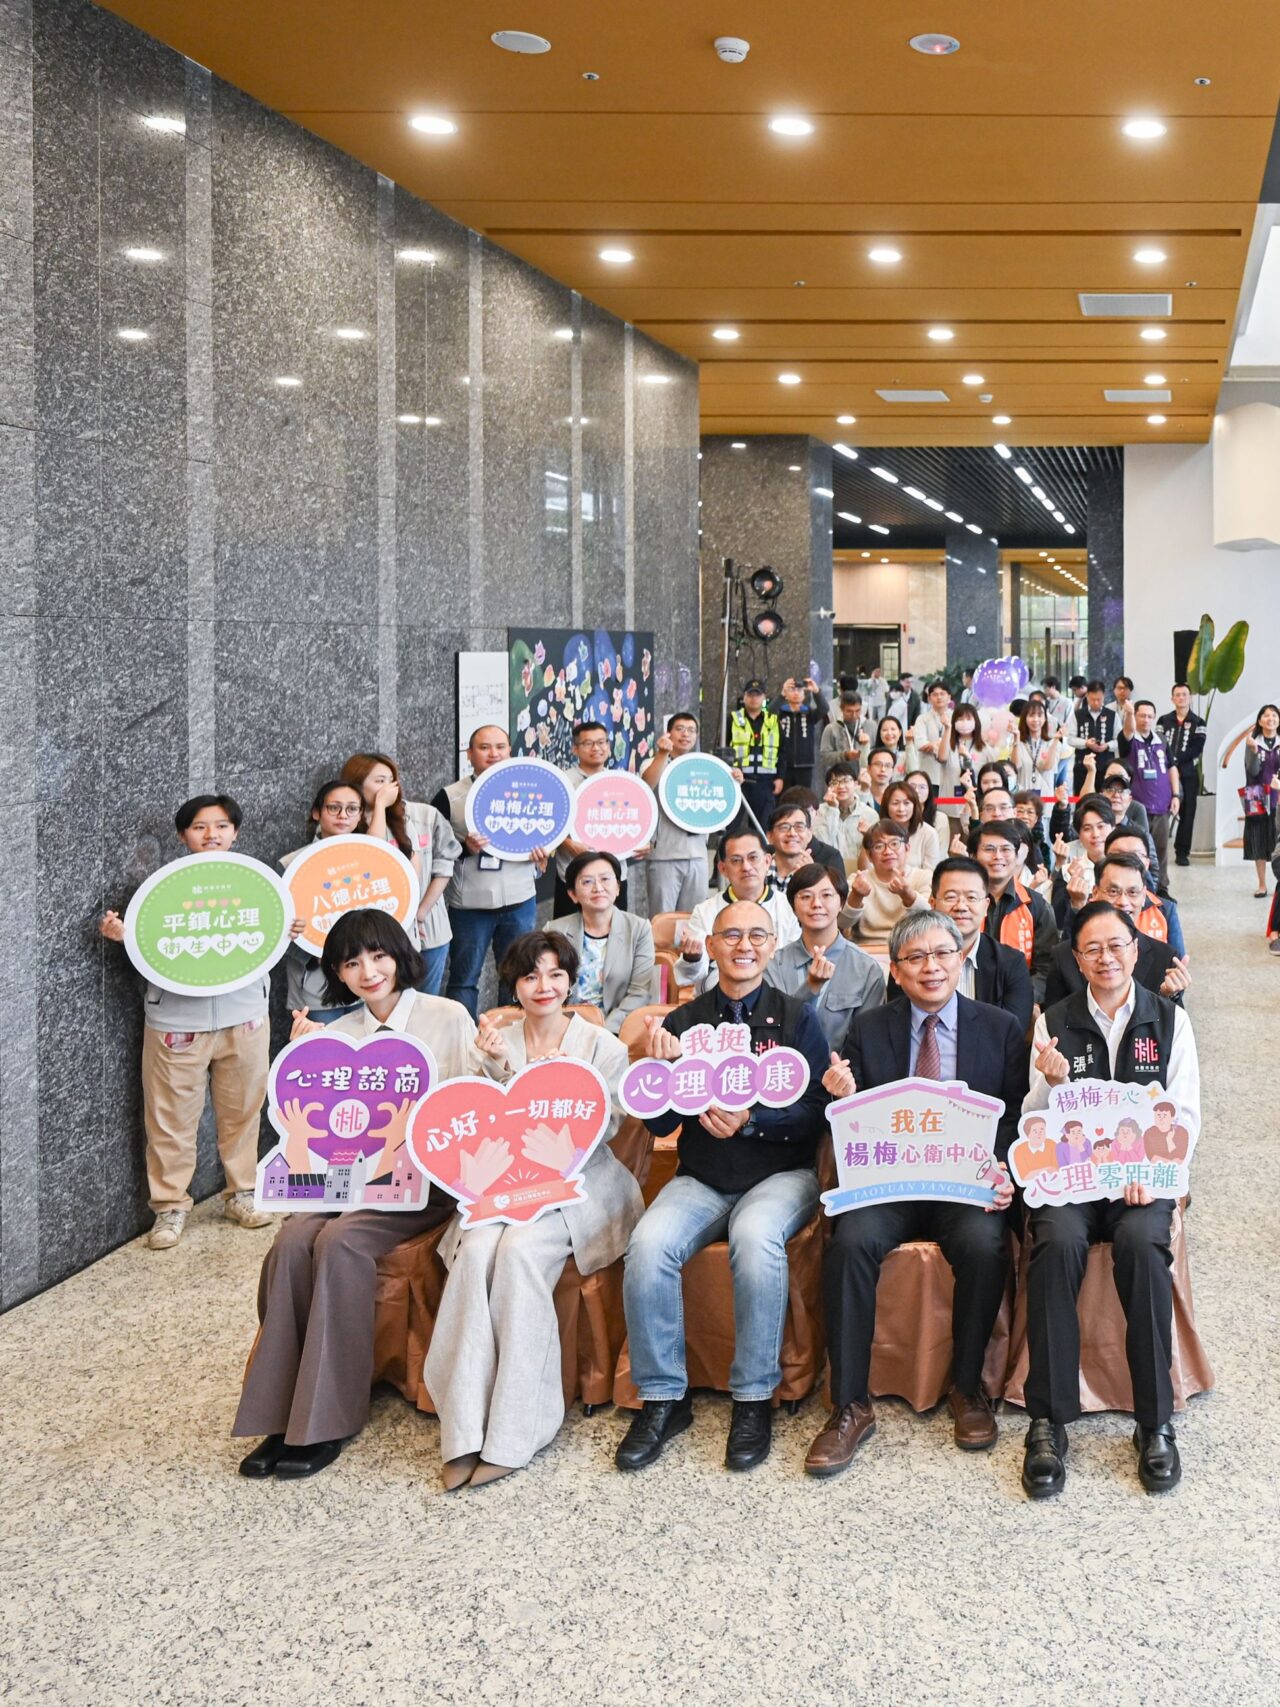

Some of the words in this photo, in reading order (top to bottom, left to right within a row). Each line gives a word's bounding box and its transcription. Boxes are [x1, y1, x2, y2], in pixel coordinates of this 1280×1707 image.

[490, 799, 554, 816] 楊梅心理
[313, 877, 392, 913] 八德心理
[162, 907, 260, 934] 平鎮心理
[162, 938, 260, 955] 衛生中心
[686, 1027, 746, 1056] 我挺
[1086, 1043, 1095, 1065] 市長
[286, 1064, 420, 1093] 心理諮商
[630, 1060, 795, 1100] 心理健康
[1073, 1056, 1087, 1082] 張
[1055, 1085, 1140, 1112] 楊梅有心
[426, 1098, 598, 1152] 心好，一切都好
[890, 1108, 943, 1134] 我在
[844, 1141, 989, 1167] 楊梅心衛中心
[853, 1182, 917, 1201] TAOYUAN
[1030, 1162, 1180, 1198] 心理零距離
